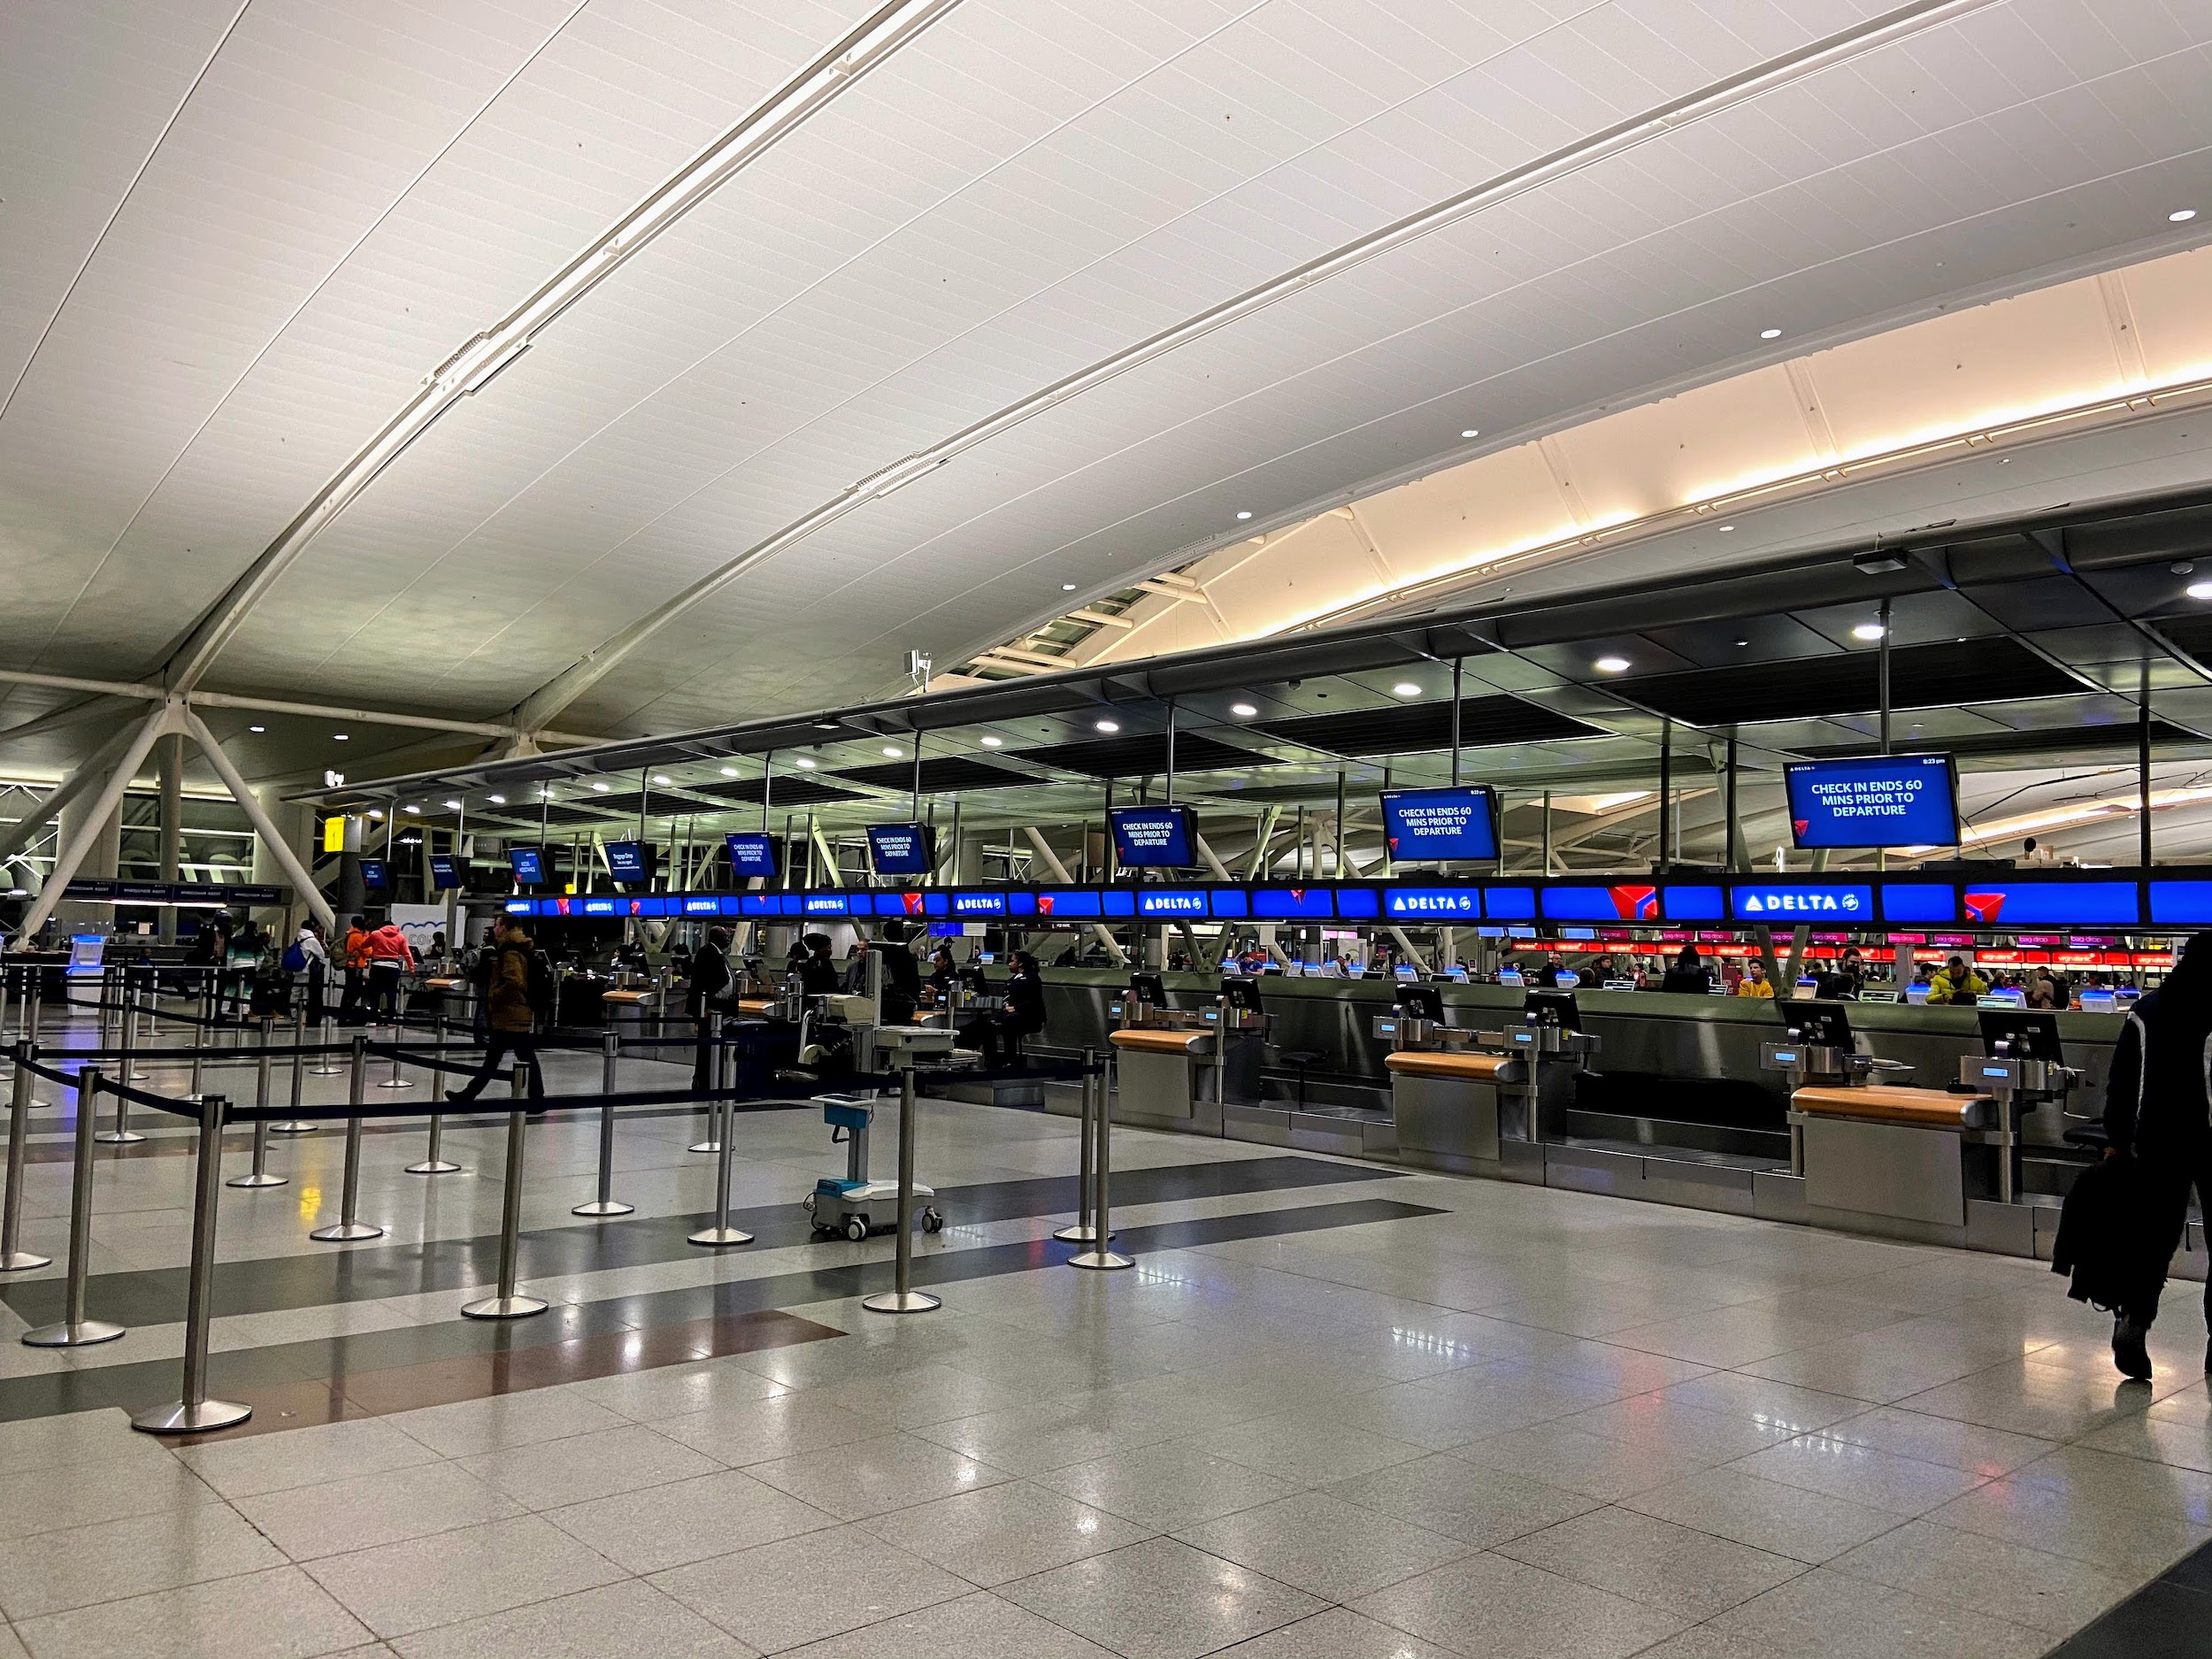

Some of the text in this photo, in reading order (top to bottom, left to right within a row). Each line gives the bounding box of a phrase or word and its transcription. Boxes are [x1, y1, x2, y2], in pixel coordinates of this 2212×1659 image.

[1812, 780, 1923, 795] CHECK IN ENDS 60
[1822, 792, 1914, 806] MINS PRIOR TO
[1398, 807, 1472, 817] CHECK IN ENDS 60
[1833, 805, 1906, 817] DEPARTURE
[1406, 817, 1467, 827] MINS PRIOR TO
[1414, 826, 1462, 836] DEPARTURE
[815, 901, 837, 909] DELTA
[965, 899, 993, 909] DELTA
[1155, 898, 1191, 909] DELTA
[1408, 897, 1456, 910] DELTA
[1767, 895, 1837, 910] DELTA
